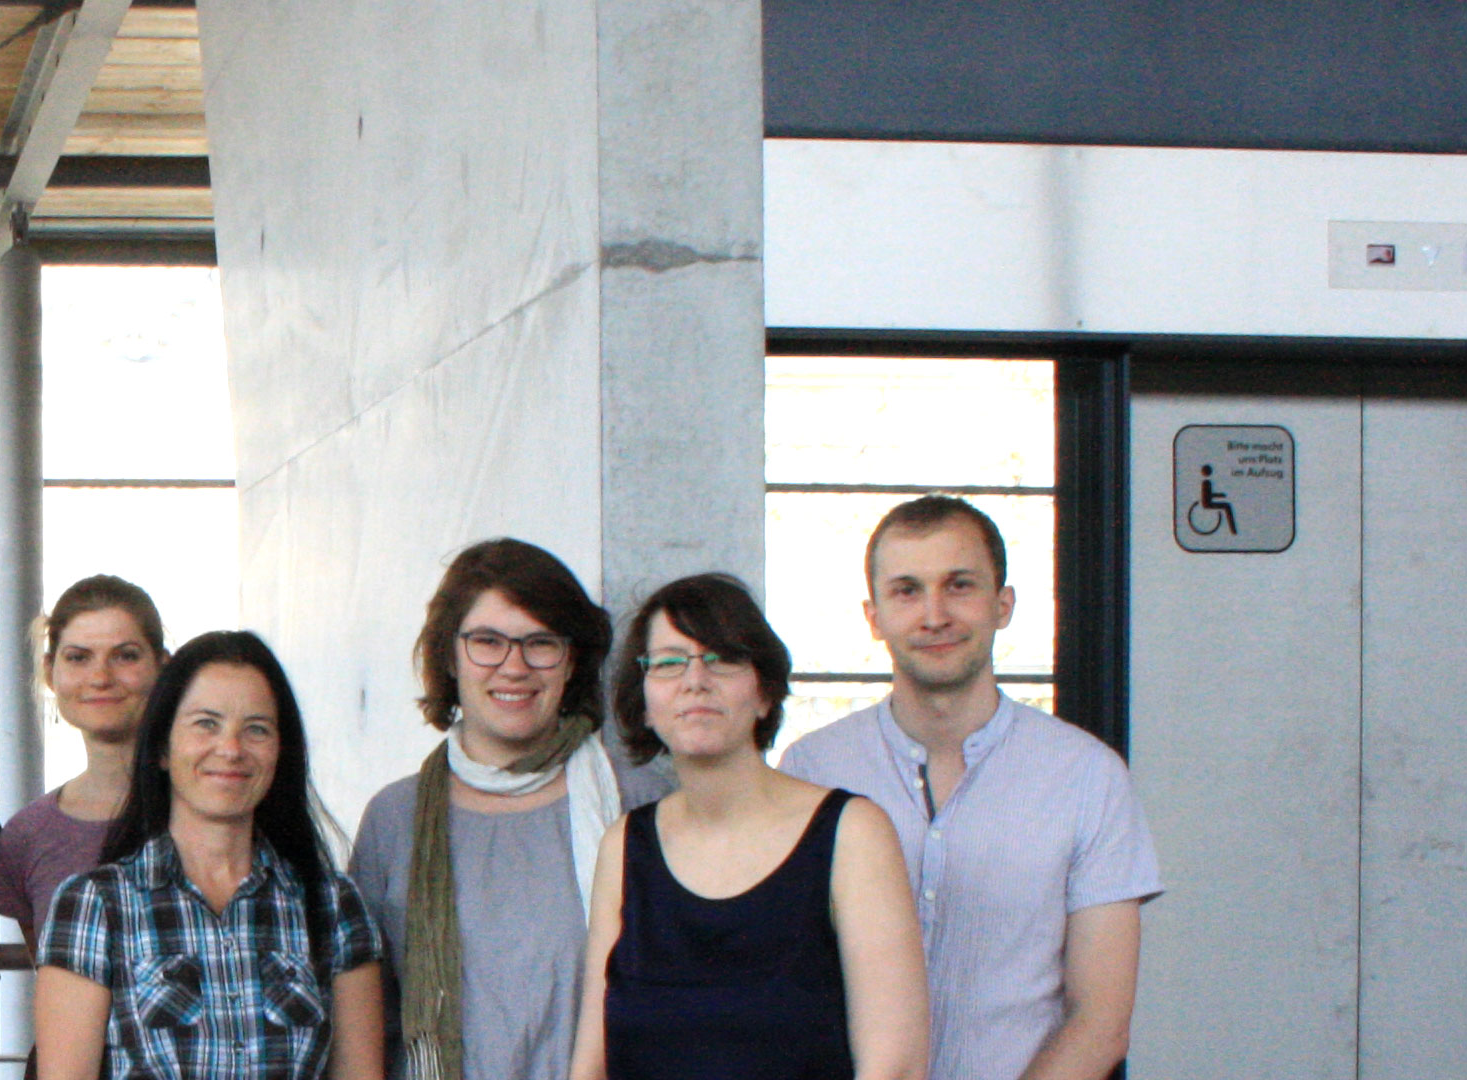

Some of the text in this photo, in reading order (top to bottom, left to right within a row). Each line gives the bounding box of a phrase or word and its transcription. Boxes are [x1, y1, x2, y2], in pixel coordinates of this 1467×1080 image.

[1227, 440, 1249, 451] Bitte
[1258, 454, 1282, 464] Platz
[1246, 467, 1284, 480] Aufzug
